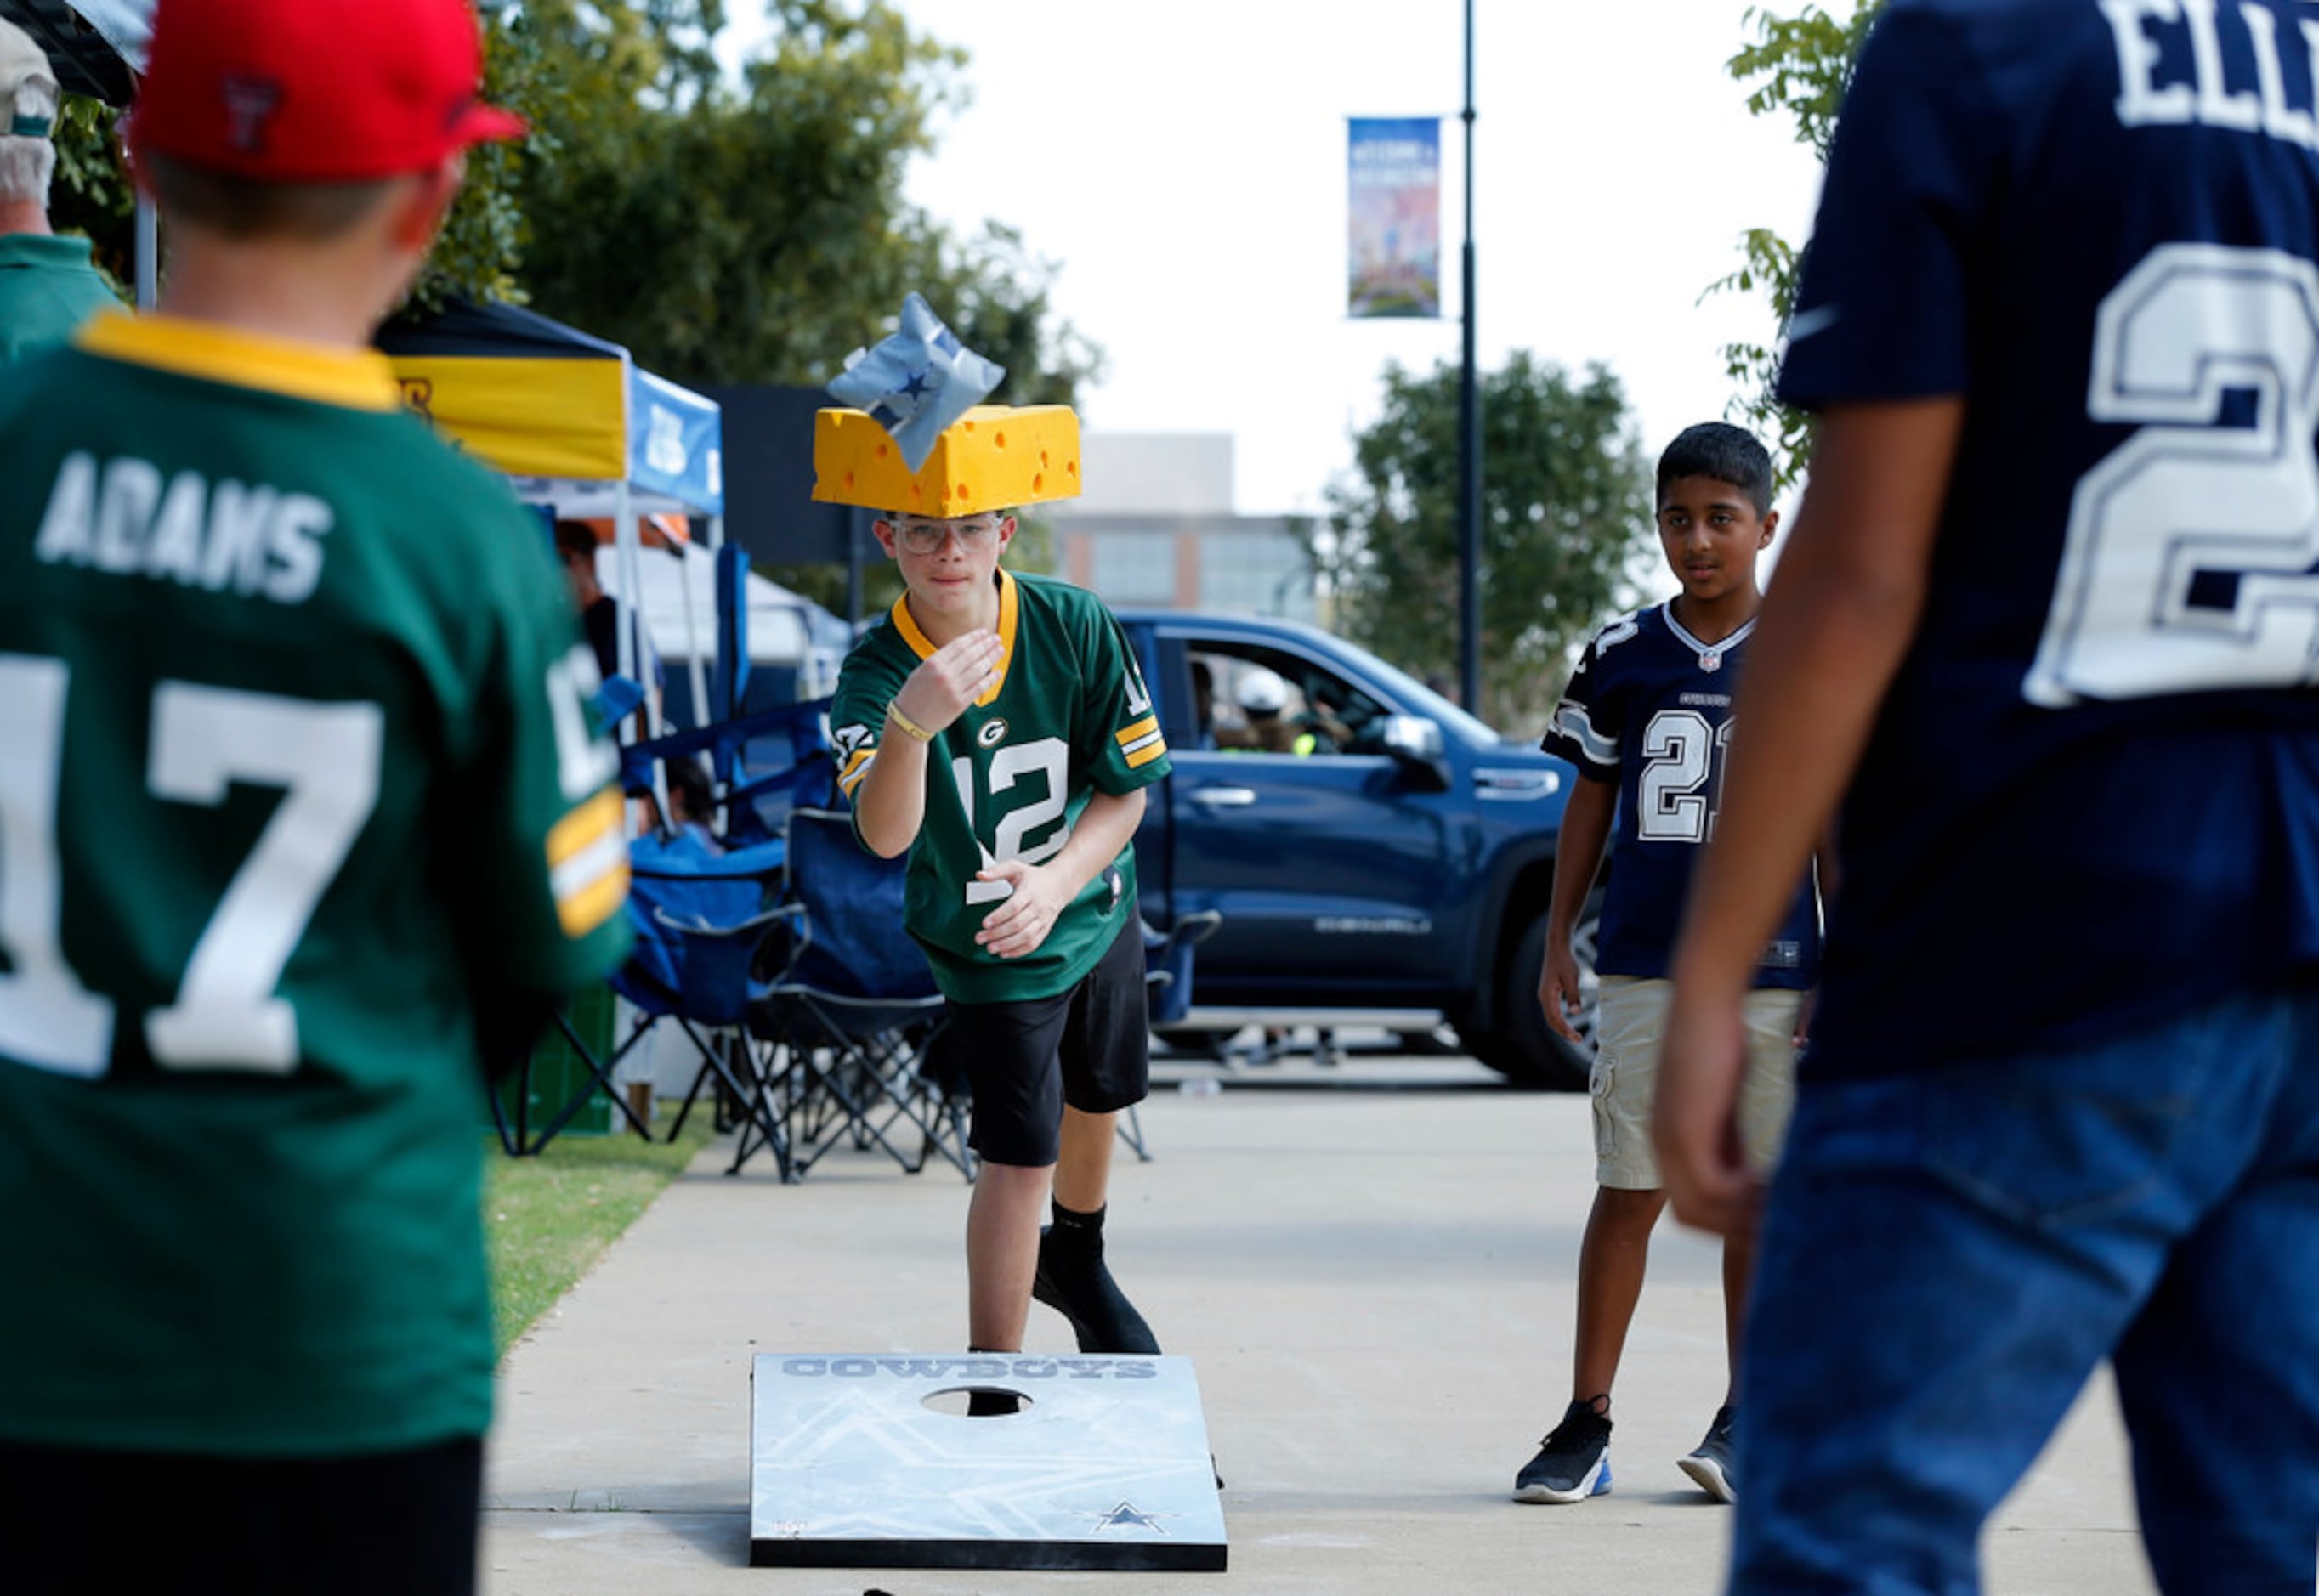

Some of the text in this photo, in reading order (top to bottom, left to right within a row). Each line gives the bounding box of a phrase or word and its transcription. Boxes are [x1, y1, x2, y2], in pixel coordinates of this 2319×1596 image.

[2098, 0, 2319, 151] ELL
[34, 450, 337, 602] ADAMS
[978, 719, 1008, 748] G
[0, 652, 385, 1079] 17
[781, 1359, 1159, 1379] COWBOYS
